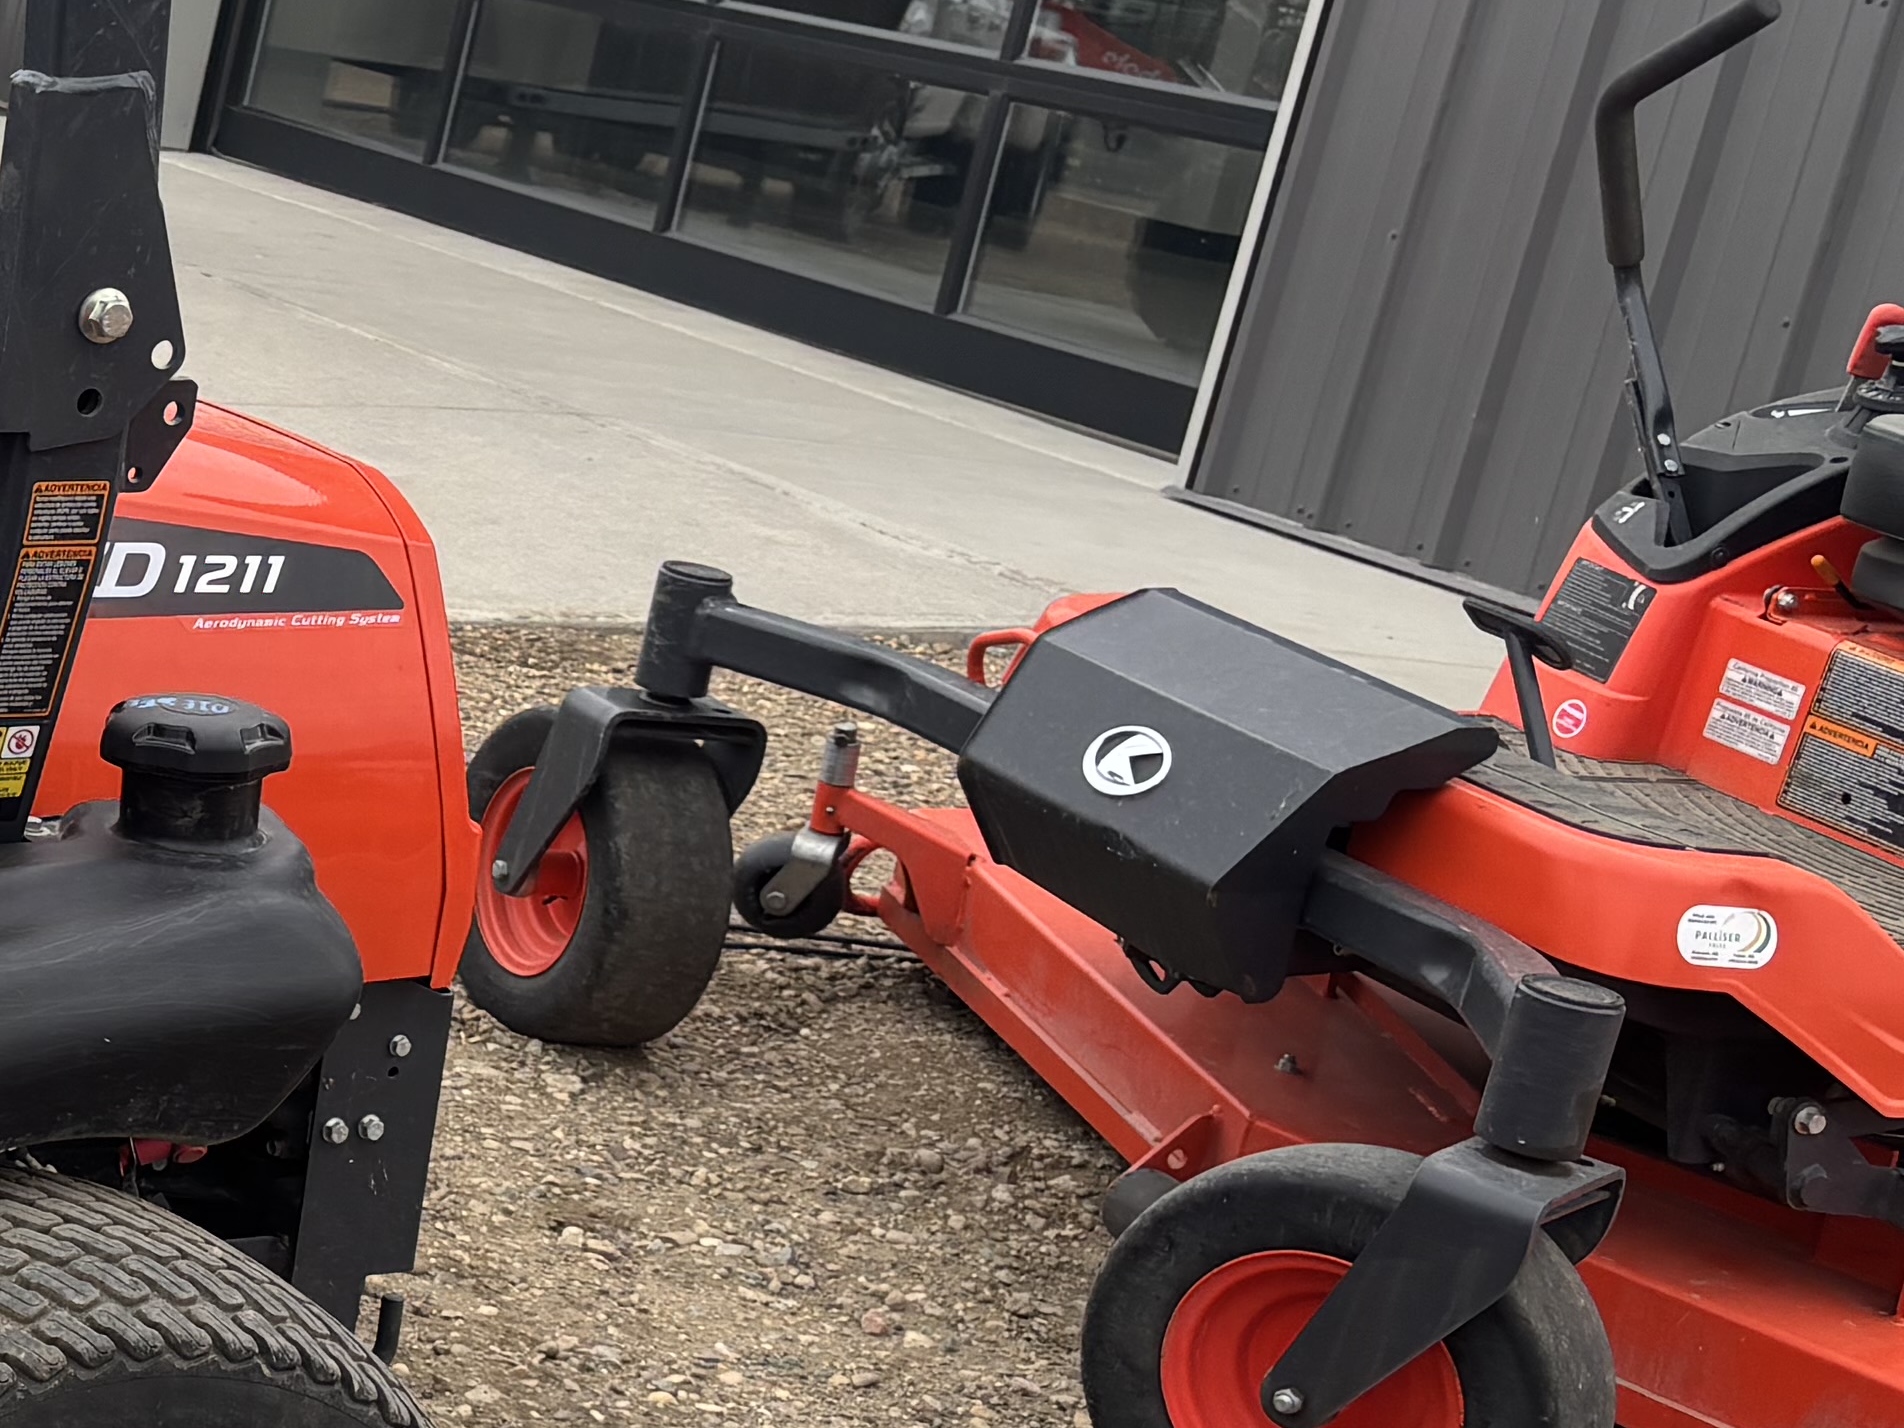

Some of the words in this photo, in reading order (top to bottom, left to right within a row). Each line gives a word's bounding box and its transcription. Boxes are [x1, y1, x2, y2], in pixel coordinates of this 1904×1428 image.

[44, 483, 108, 493] ADVERTENCIA
[94, 541, 166, 598] D
[173, 555, 286, 594] 1211
[193, 616, 286, 631] Aerodynamic
[291, 613, 345, 628] Cutting
[349, 612, 401, 626] System
[1818, 725, 1870, 751] ADVERTENCIA
